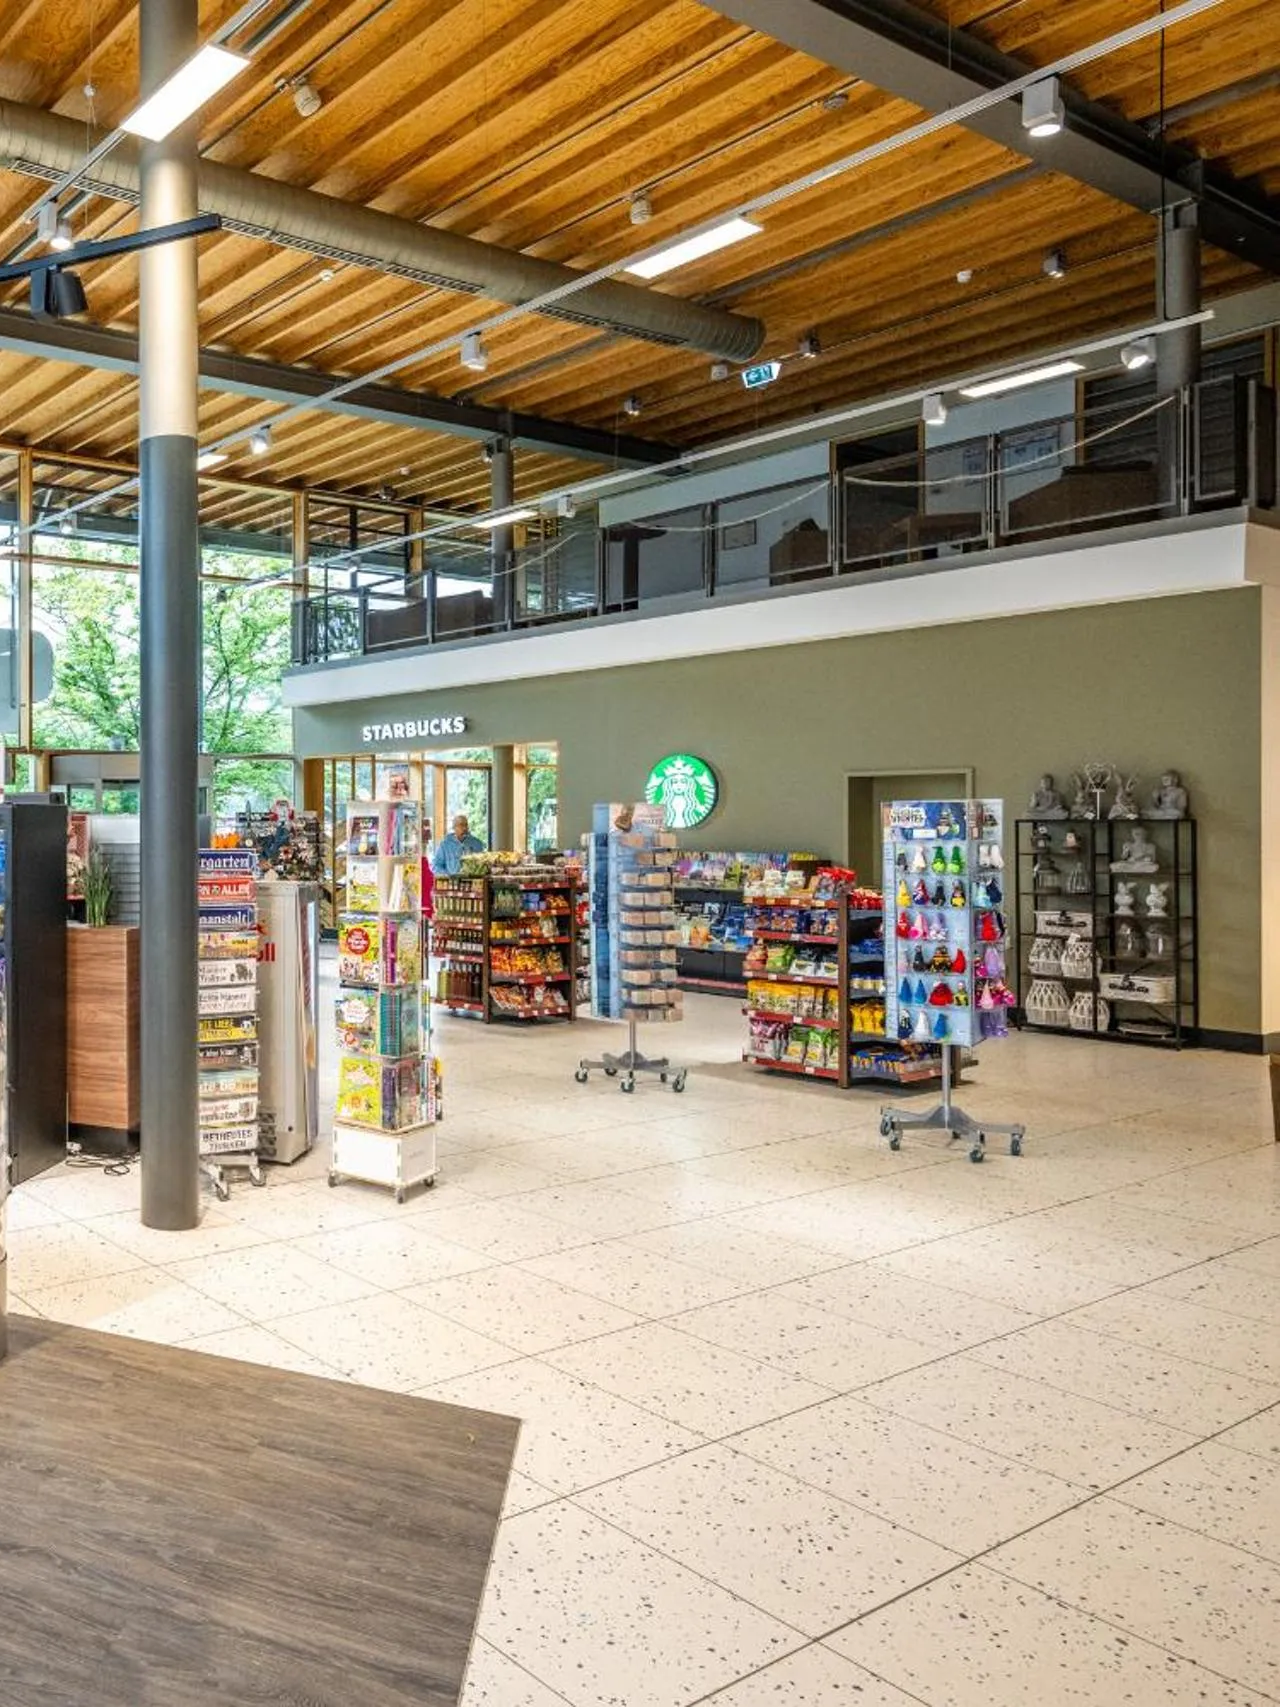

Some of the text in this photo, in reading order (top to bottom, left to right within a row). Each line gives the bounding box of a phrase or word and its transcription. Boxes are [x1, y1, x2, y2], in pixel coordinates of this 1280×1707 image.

[362, 716, 465, 741] STARBUCKS
[200, 855, 249, 871] rgarten
[199, 911, 248, 925] nanstalt
